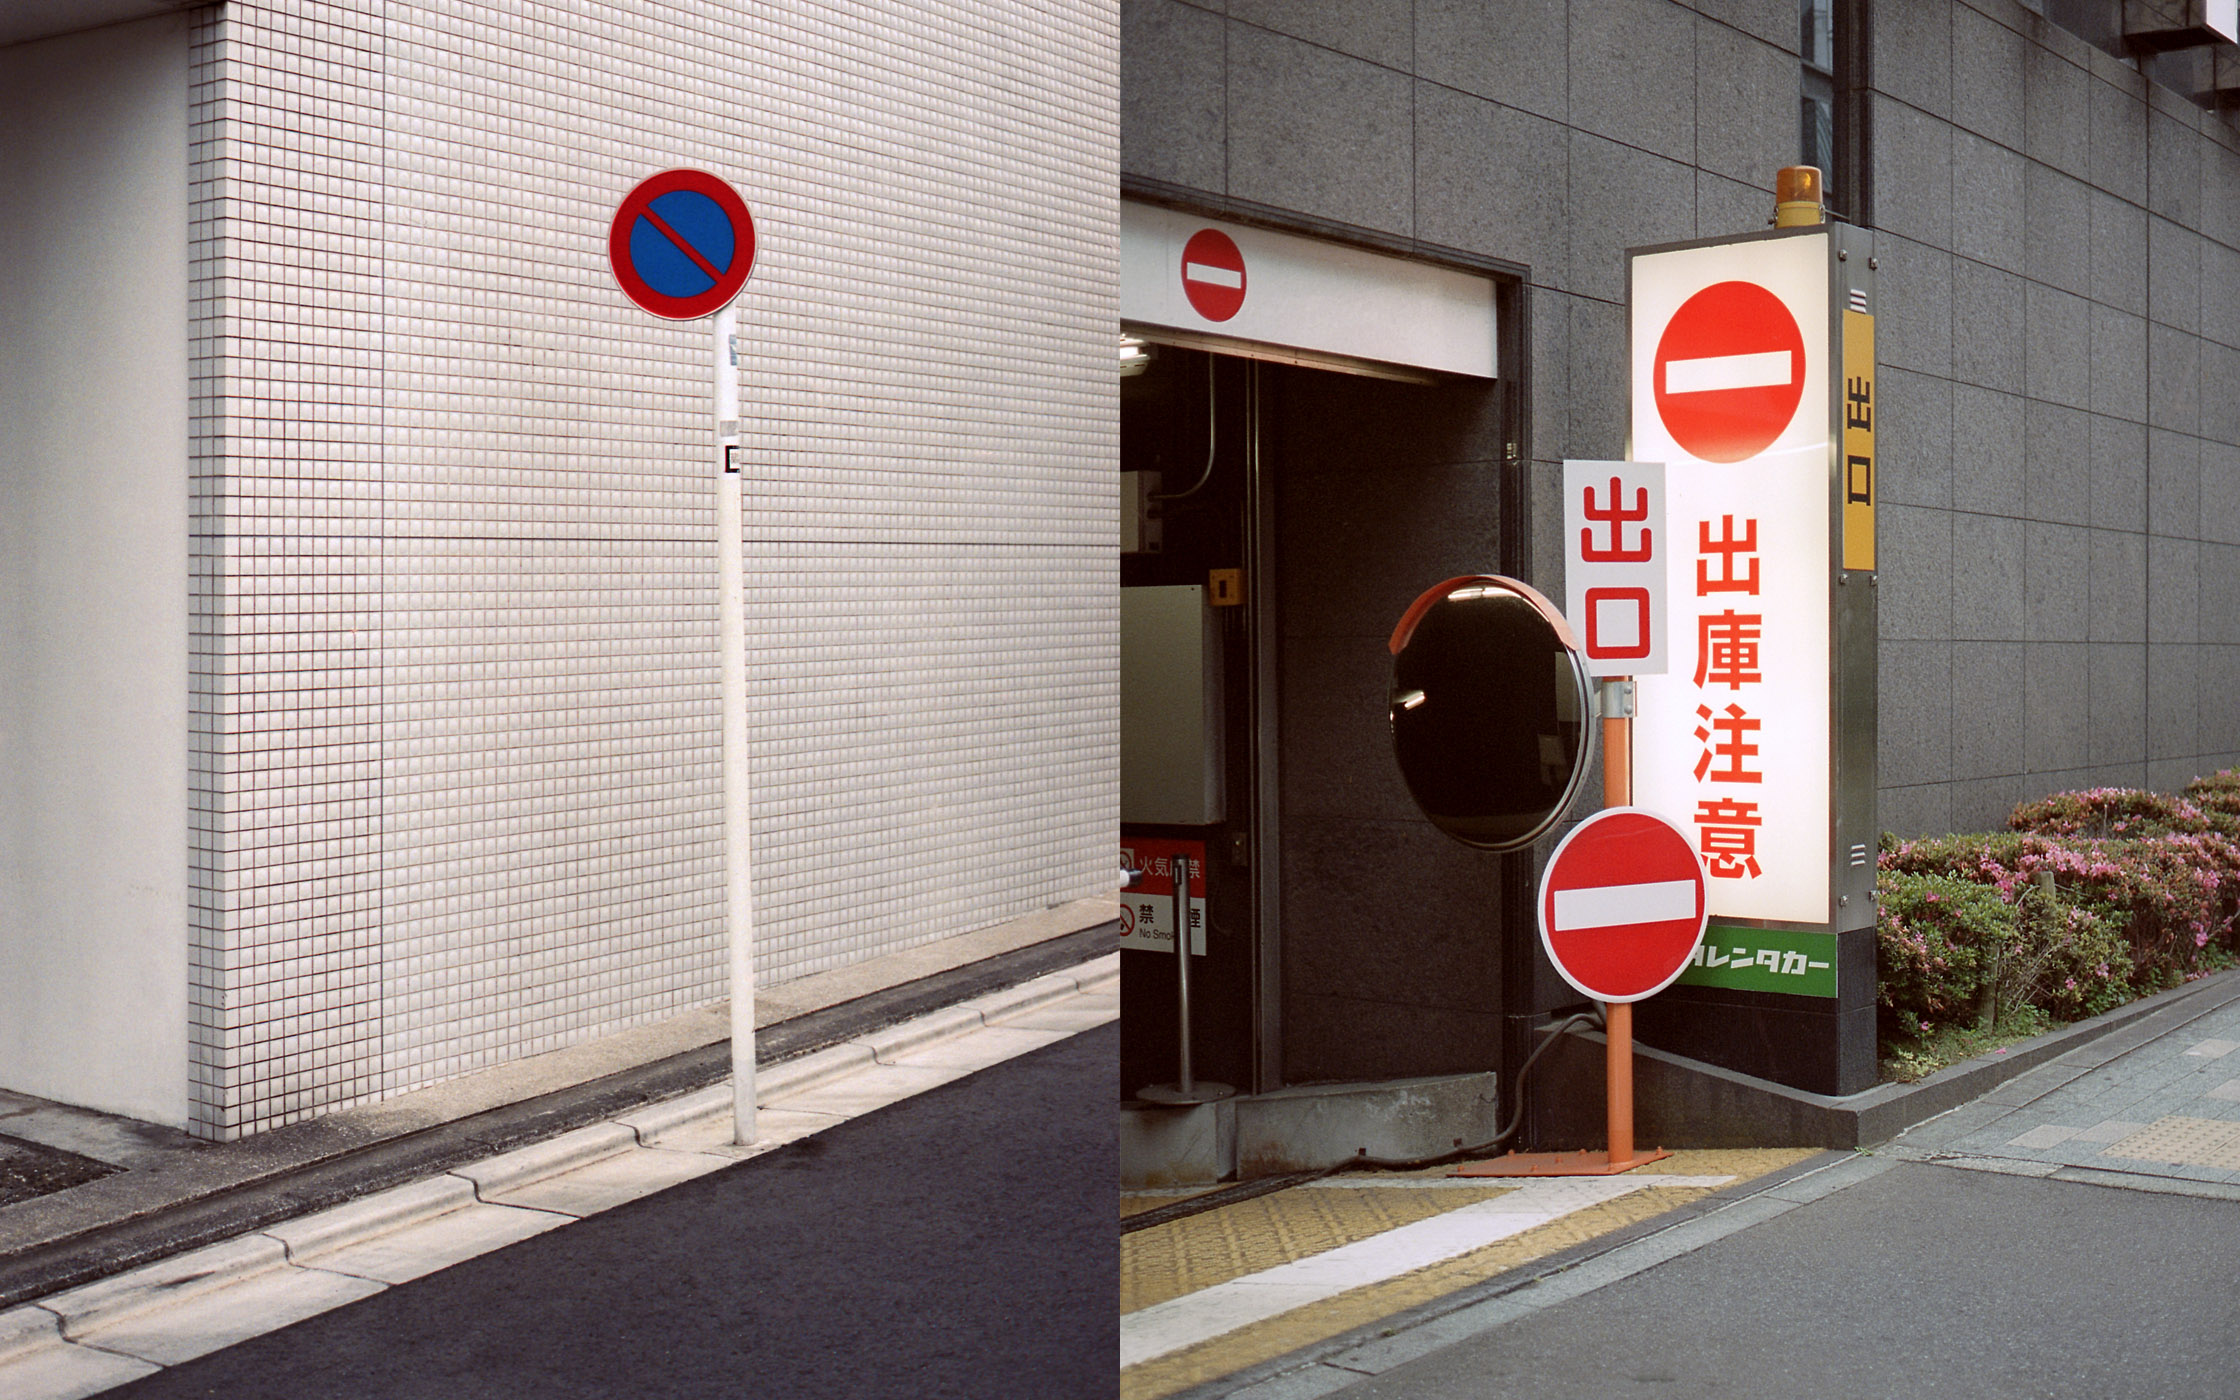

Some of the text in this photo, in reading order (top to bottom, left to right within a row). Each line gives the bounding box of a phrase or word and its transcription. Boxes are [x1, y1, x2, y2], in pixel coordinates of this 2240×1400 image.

[1847, 376, 1872, 507] 出口
[1580, 476, 1652, 660] 出口
[1693, 514, 1762, 879] 出庫注意
[1139, 855, 1201, 879] 火気禁
[1139, 928, 1151, 939] No
